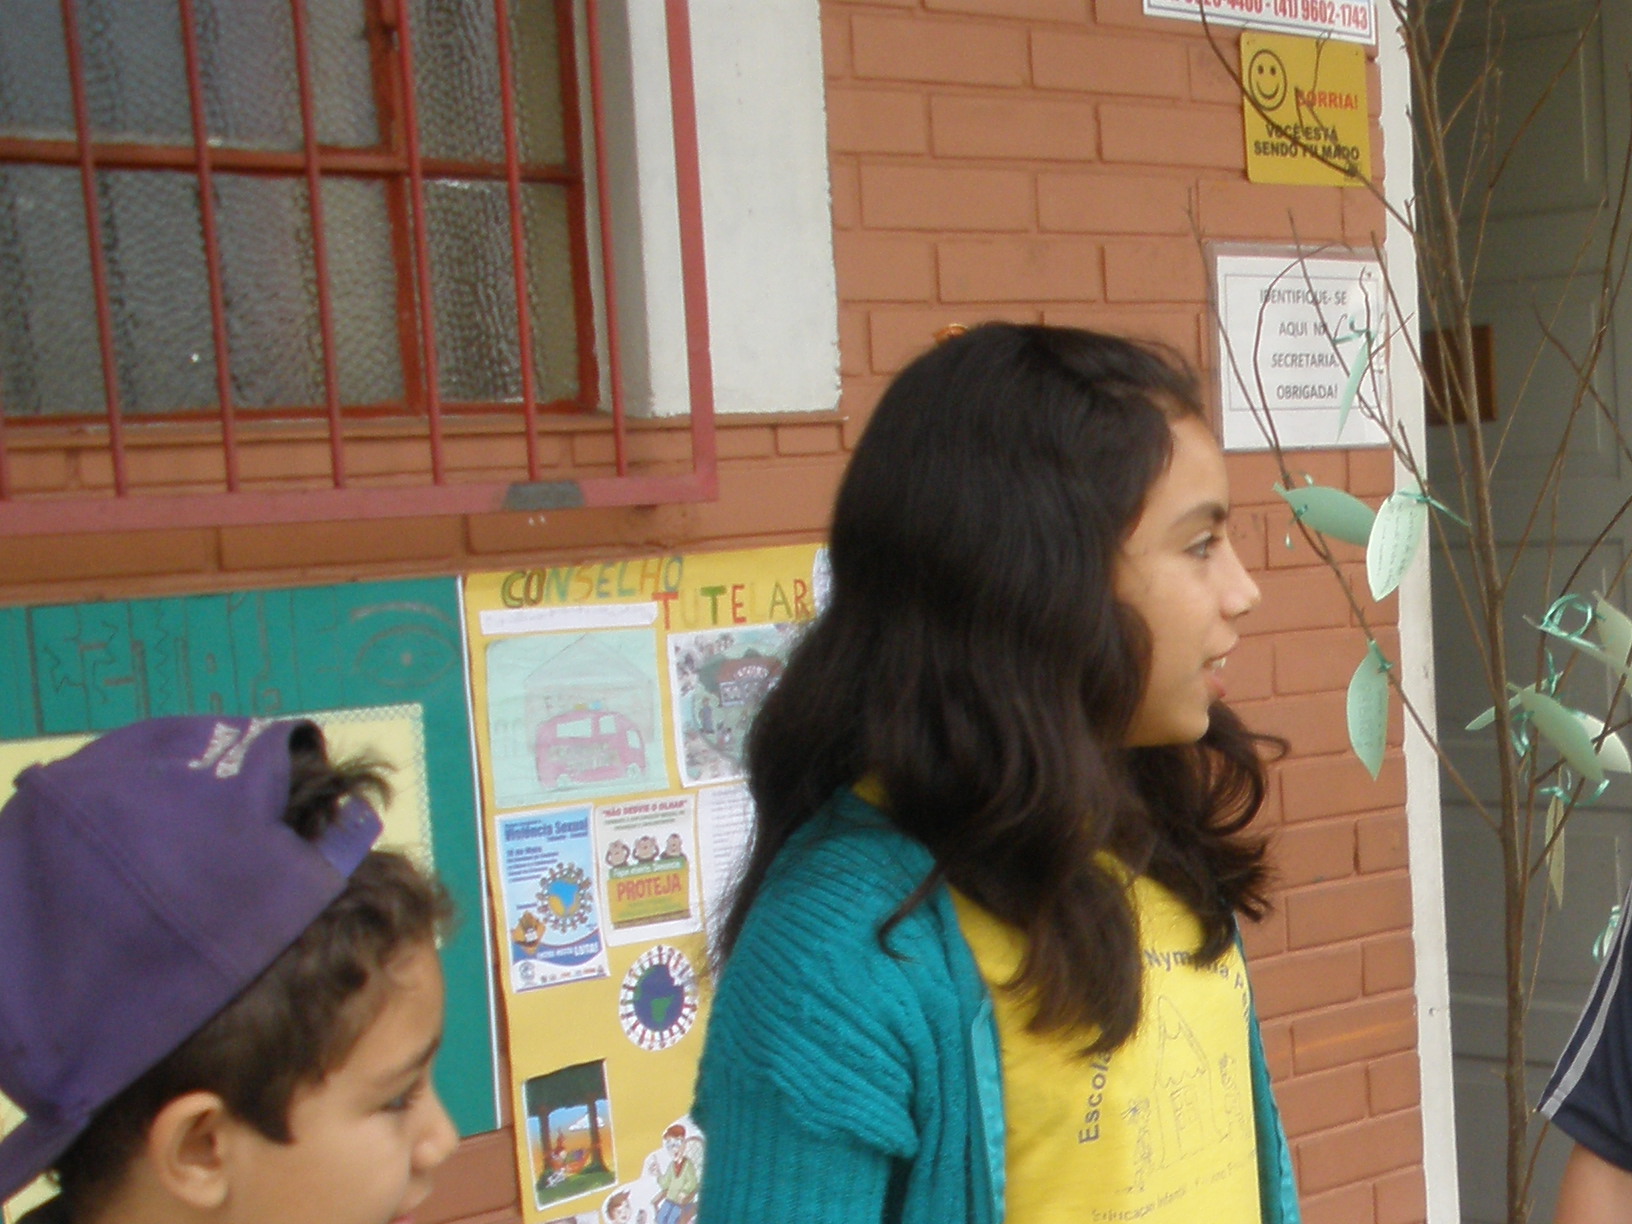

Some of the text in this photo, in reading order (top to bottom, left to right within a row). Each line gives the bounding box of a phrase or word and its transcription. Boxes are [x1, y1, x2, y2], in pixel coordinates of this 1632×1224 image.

[1301, 1, 1368, 30] 9602-1743
[1297, 90, 1358, 111] SORRIA!
[1253, 140, 1298, 158] SENDO
[1279, 322, 1307, 336] AQUI
[1276, 384, 1338, 399] OBRIGADA!
[501, 554, 684, 609] CONSELHO
[651, 578, 813, 632] TUTELAR
[616, 873, 682, 902] PROTEJA
